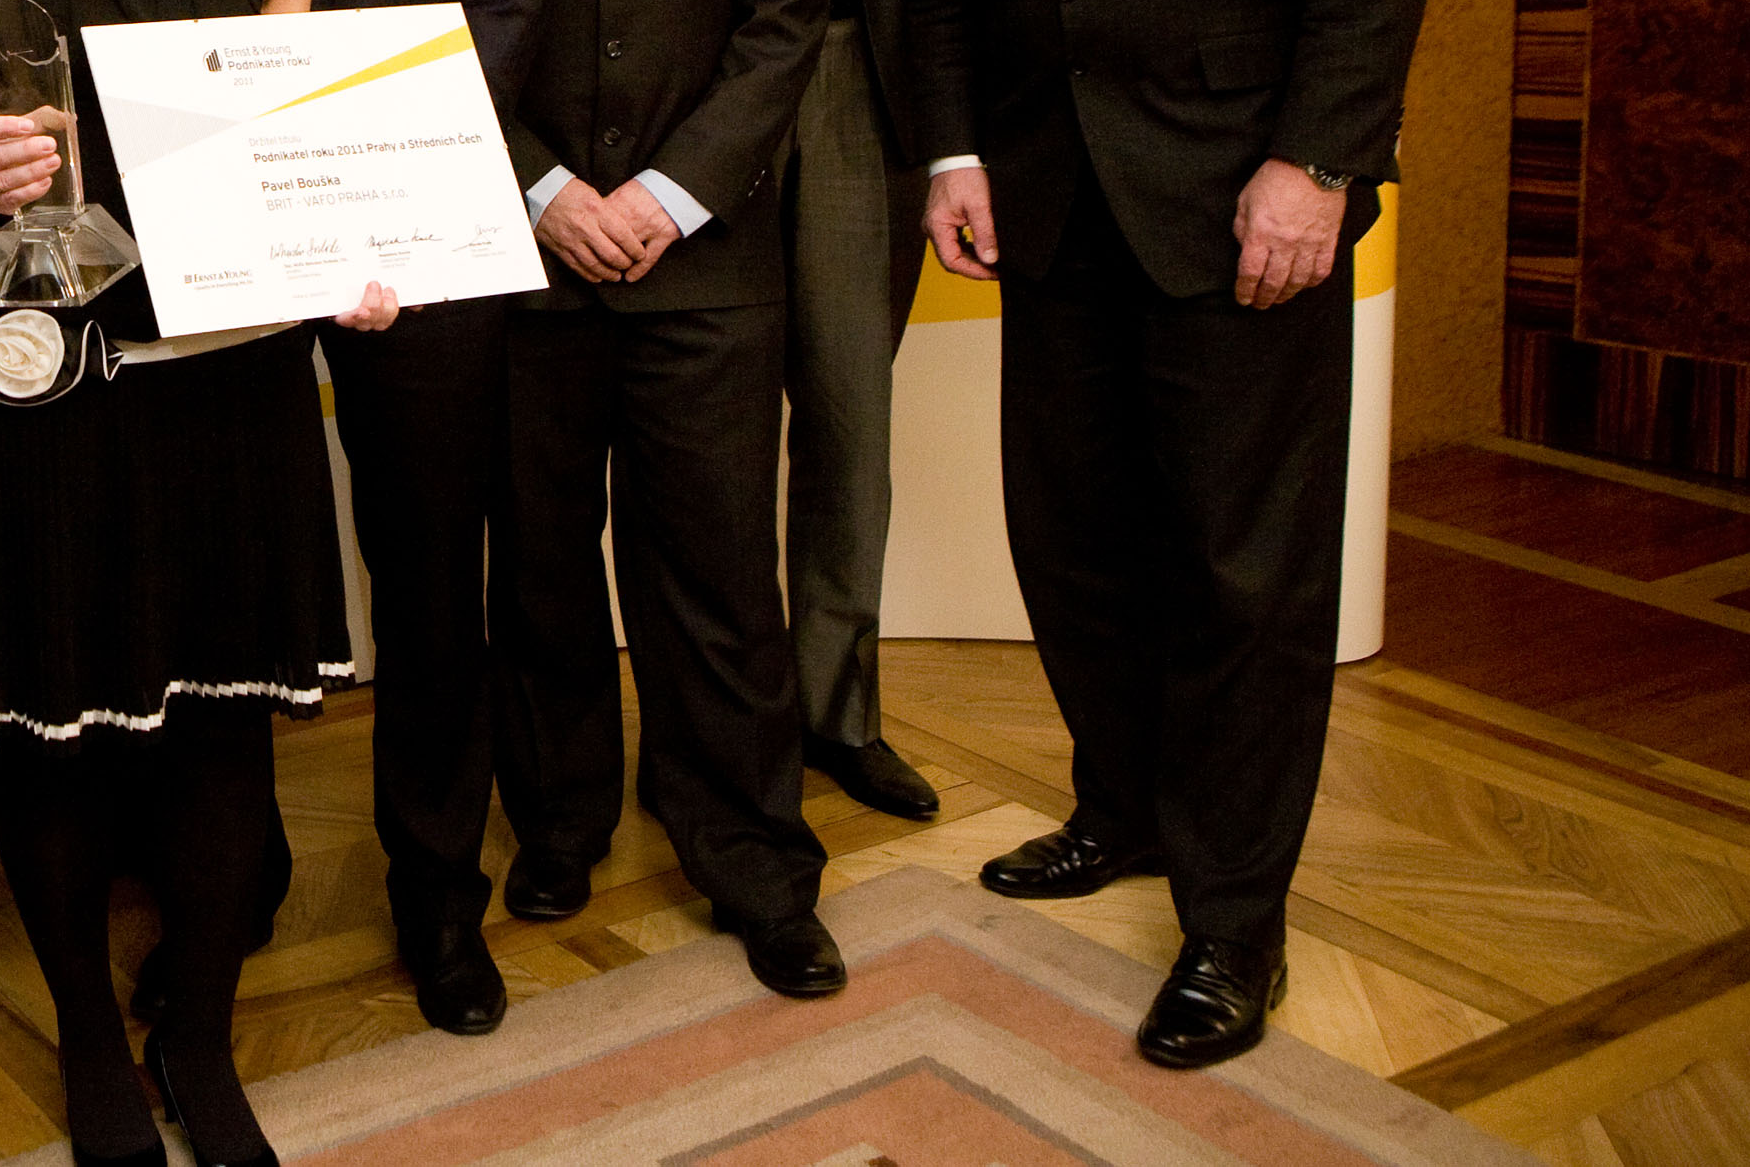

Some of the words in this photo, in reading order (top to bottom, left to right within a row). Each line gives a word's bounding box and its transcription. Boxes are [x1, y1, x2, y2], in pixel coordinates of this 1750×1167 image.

[223, 46, 251, 59] Ernst
[251, 45, 260, 57] &
[260, 44, 292, 57] Young
[227, 57, 285, 71] Podnikatel
[233, 77, 254, 87] 2011
[253, 148, 310, 163] Podnikatel
[311, 148, 335, 159] roku
[336, 144, 365, 157] 2011
[365, 142, 397, 154] Prahy
[399, 141, 406, 151] a
[457, 132, 483, 145] Čech
[261, 178, 295, 192] Pavel
[296, 174, 342, 189] Bouška
[266, 197, 293, 212] BRIT
[303, 193, 336, 207] VAFO
[337, 189, 380, 203] PRAHA
